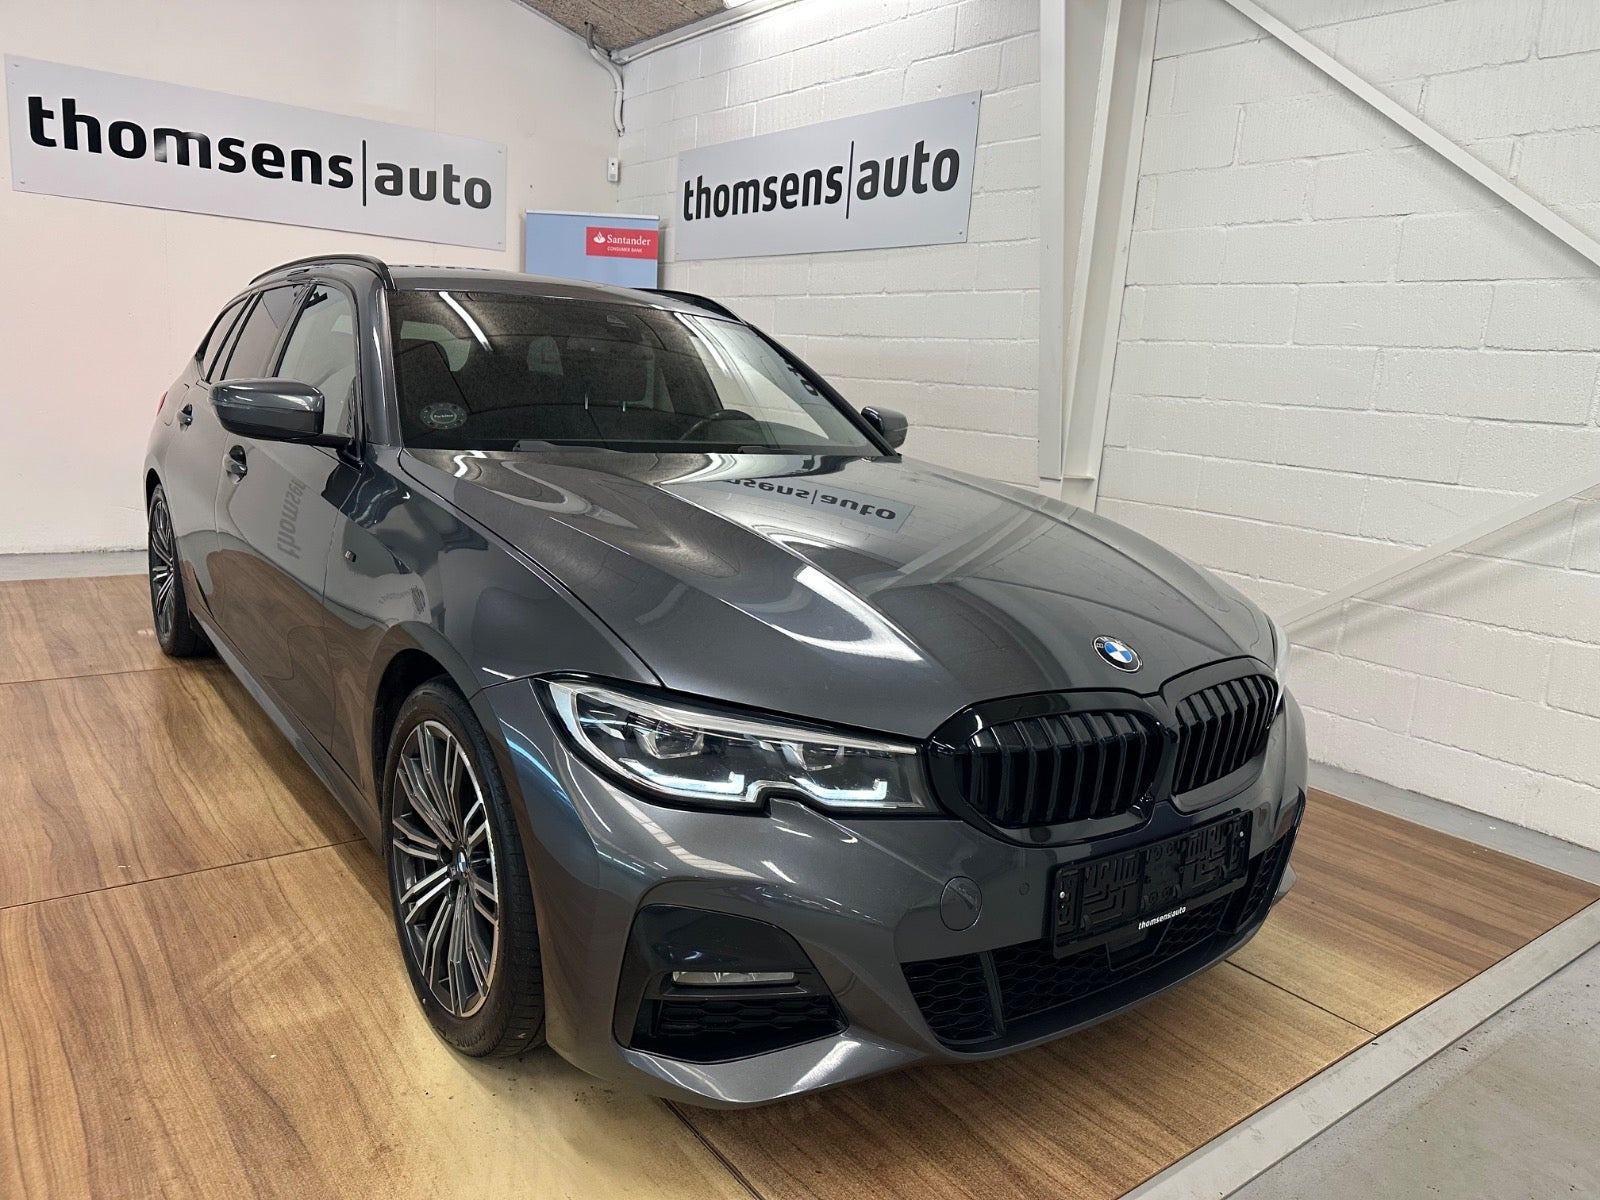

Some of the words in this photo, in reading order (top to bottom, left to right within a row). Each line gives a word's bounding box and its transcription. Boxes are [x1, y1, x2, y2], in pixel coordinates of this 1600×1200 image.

[28, 96, 354, 189] thomsens
[374, 162, 492, 210] auto
[683, 165, 844, 222] thomsens
[856, 140, 960, 201] auto
[607, 234, 651, 245] Santander
